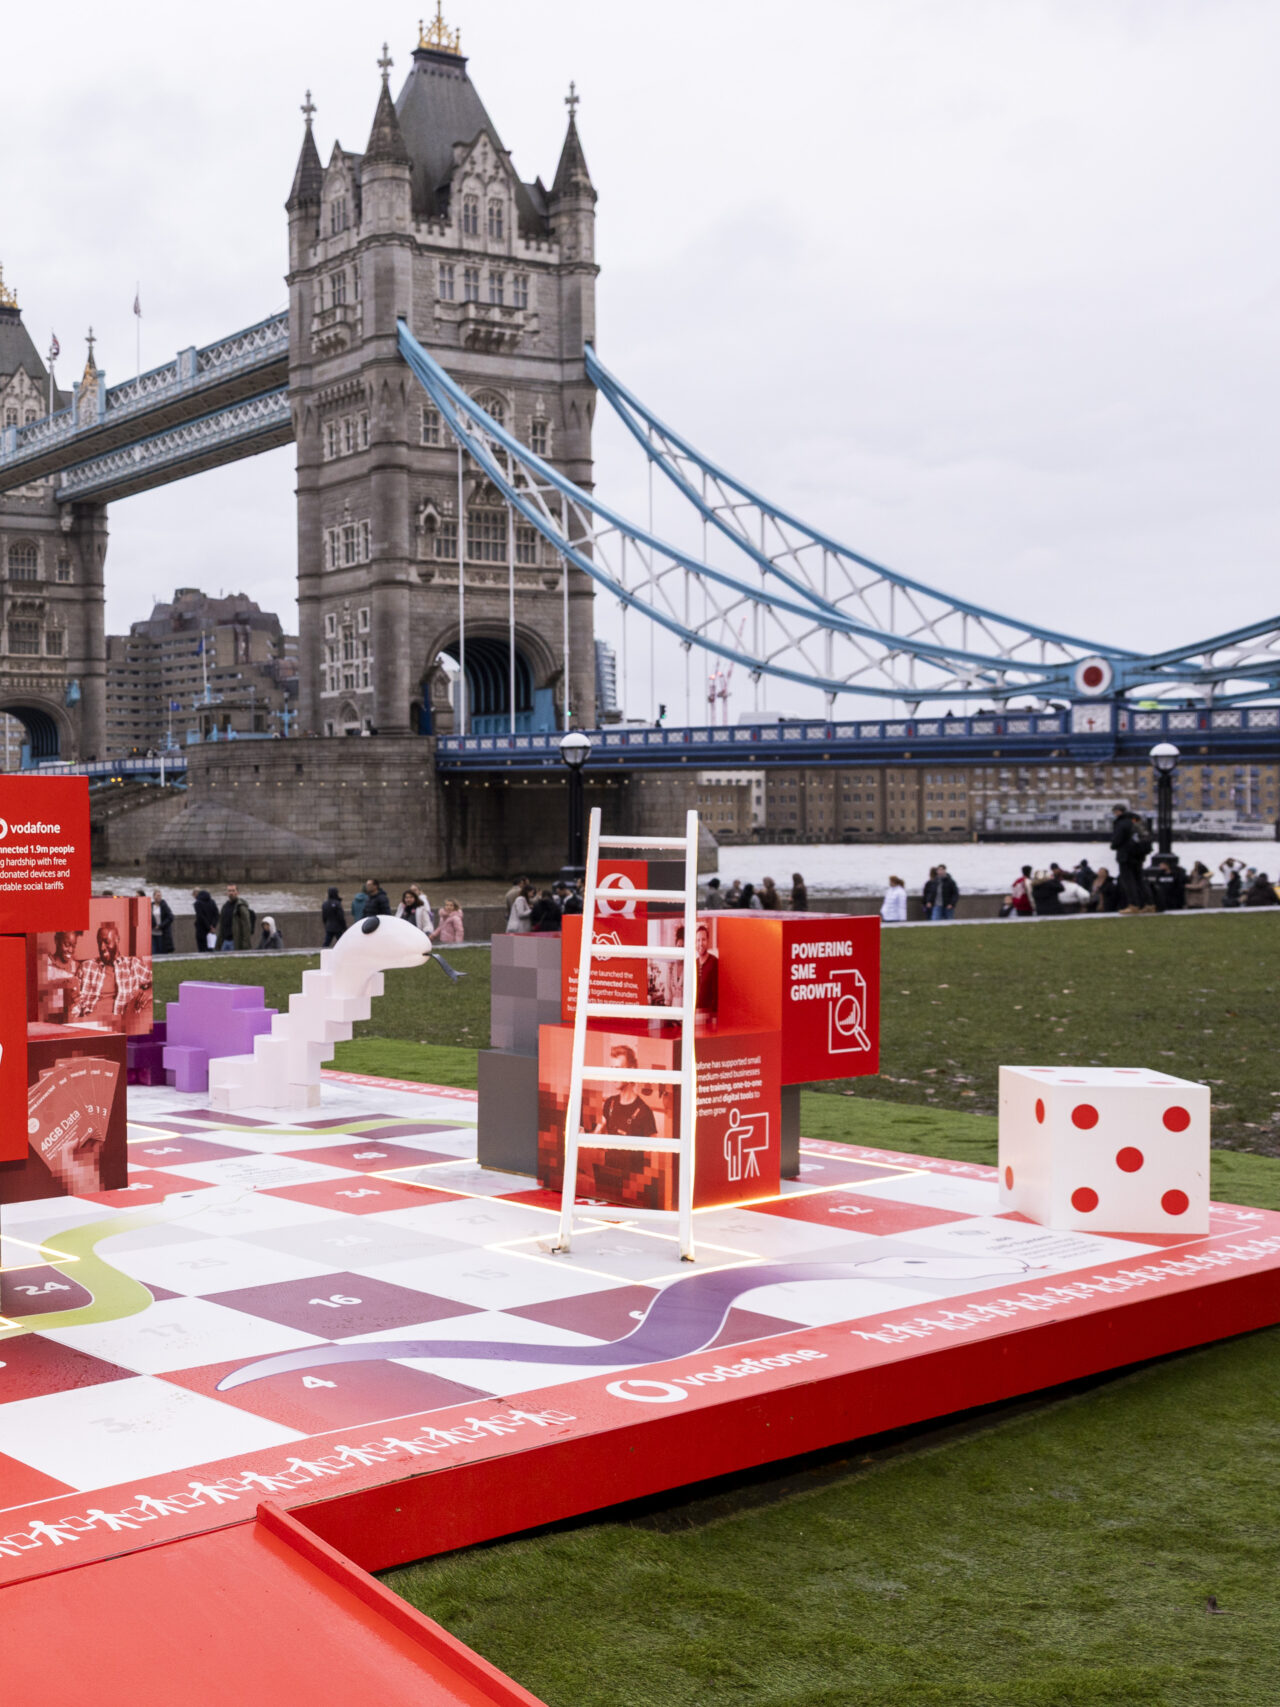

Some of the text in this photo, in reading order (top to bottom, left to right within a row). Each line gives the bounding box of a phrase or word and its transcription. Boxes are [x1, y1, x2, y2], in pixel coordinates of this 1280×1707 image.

[10, 822, 61, 834] vodafone
[30, 845, 48, 853] 1.9m
[49, 845, 75, 855] people
[6, 858, 36, 867] hardship
[37, 858, 52, 866] with
[53, 857, 67, 866] free
[0, 870, 29, 878] donated
[30, 869, 56, 878] devices
[57, 869, 70, 877] and
[23, 882, 43, 890] social
[44, 881, 64, 890] tariffs
[791, 940, 853, 959] POWERING
[791, 963, 817, 980] SME
[791, 982, 842, 1001] GROWTH
[40, 1126, 64, 1152] 40GB
[60, 1109, 81, 1131] Data
[828, 1204, 875, 1216] 12
[176, 1257, 230, 1270] 25
[460, 1268, 510, 1281] 15
[13, 1280, 71, 1297] 24
[308, 1293, 363, 1309] 16
[137, 1322, 188, 1338] 17
[671, 1348, 829, 1387] vodafone
[301, 1375, 338, 1391] 4
[88, 1416, 134, 1434] 3
